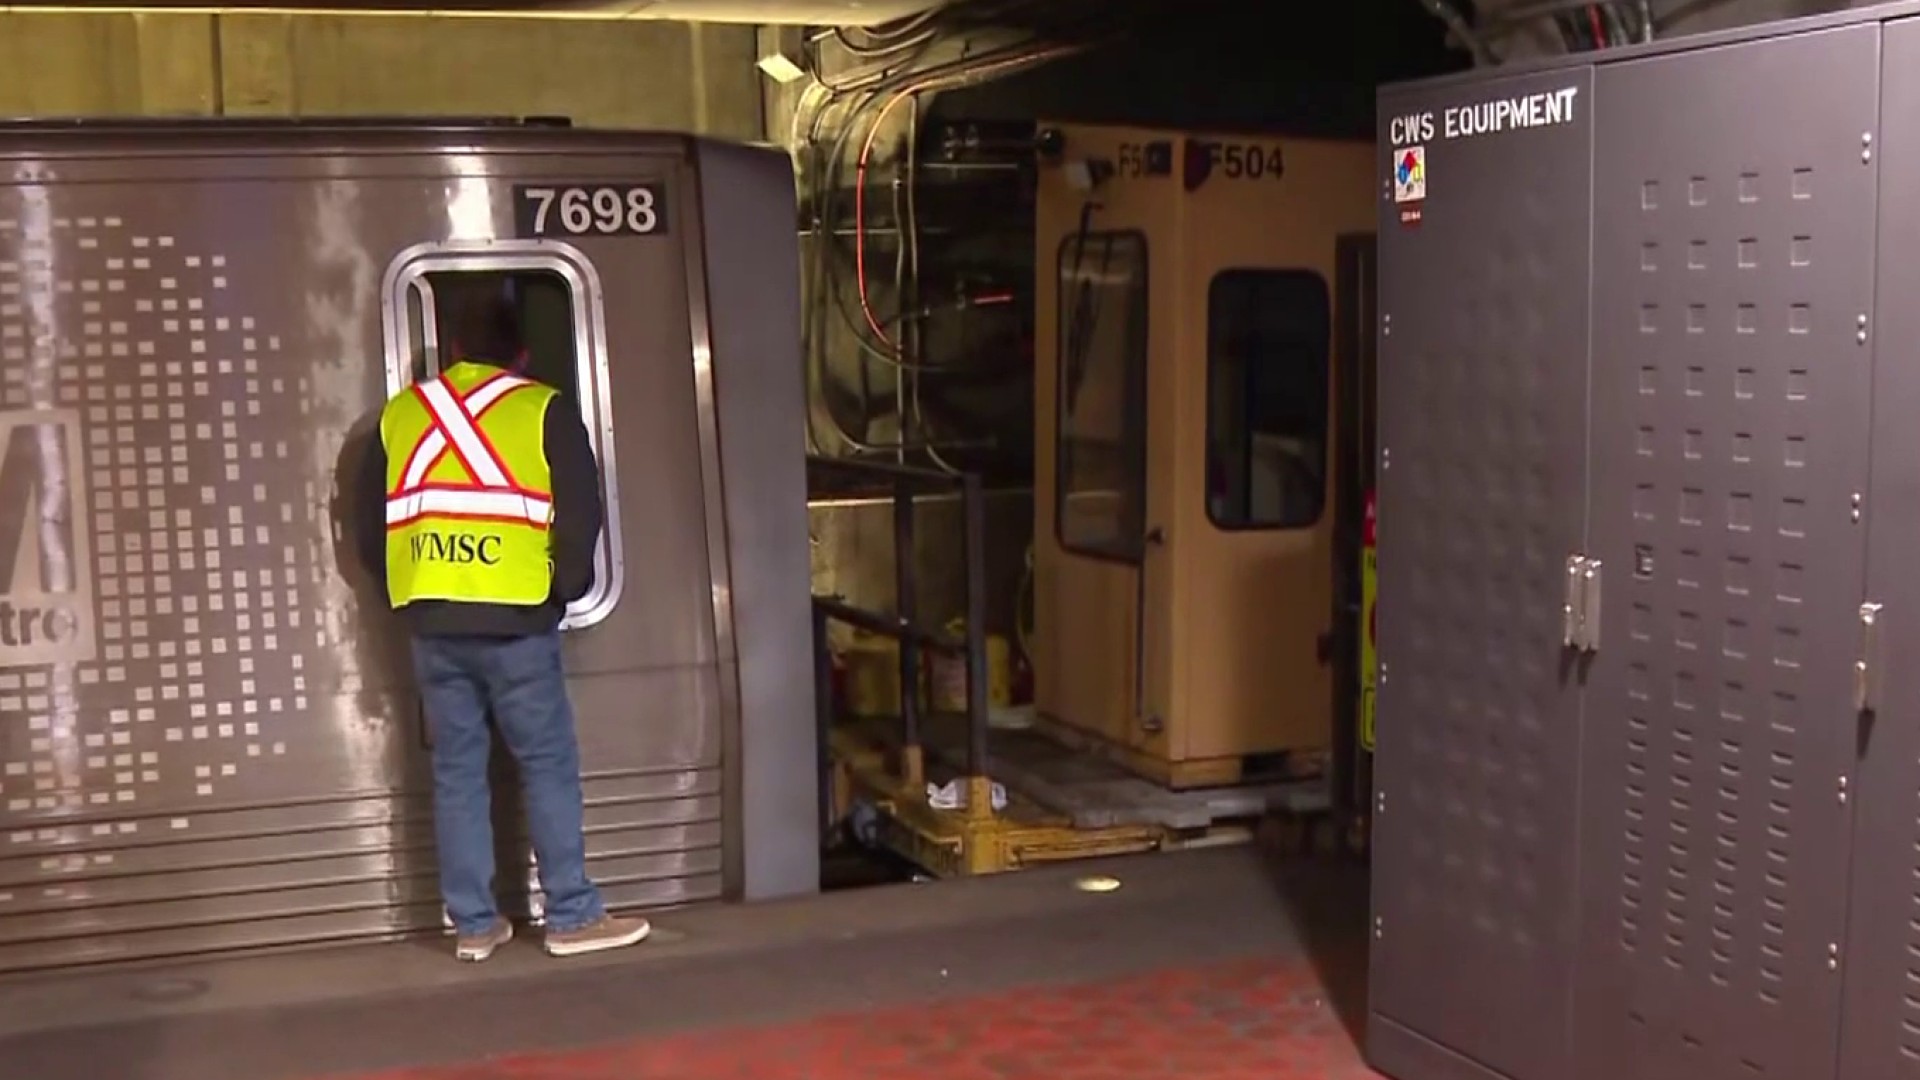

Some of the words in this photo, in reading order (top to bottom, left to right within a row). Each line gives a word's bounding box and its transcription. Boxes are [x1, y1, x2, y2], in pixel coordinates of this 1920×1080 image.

[1390, 112, 1435, 145] CWS
[1444, 86, 1578, 138] EQUIPMENT
[525, 187, 657, 234] 7698
[410, 532, 502, 566] WMSC
